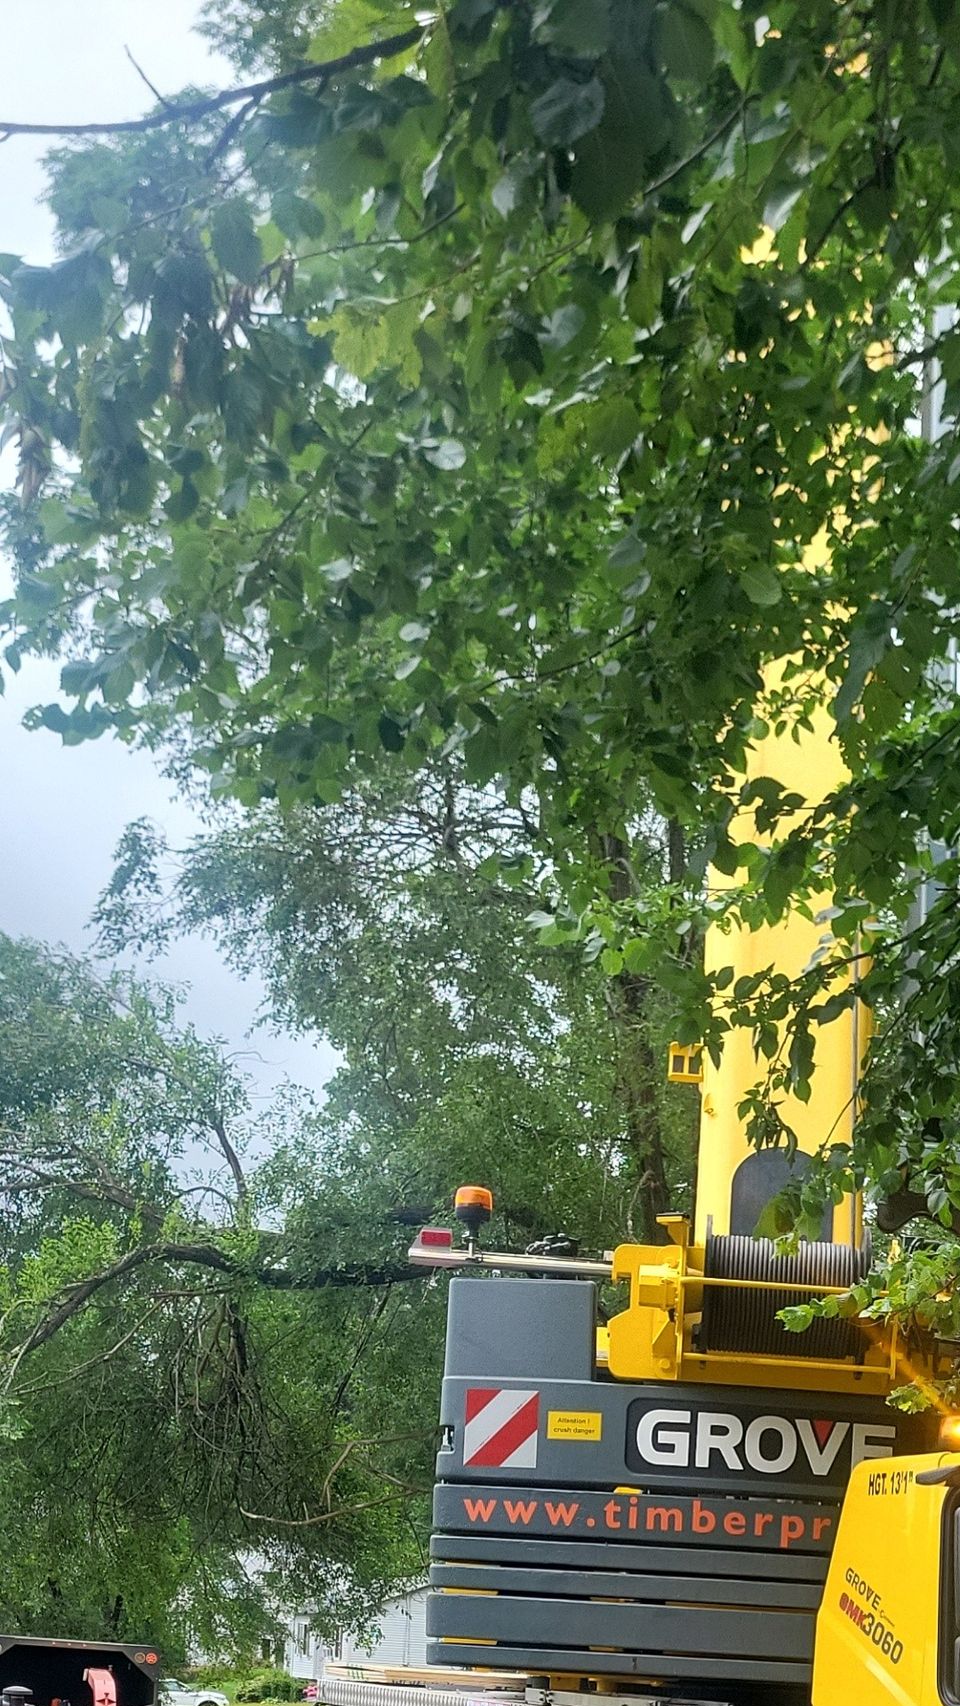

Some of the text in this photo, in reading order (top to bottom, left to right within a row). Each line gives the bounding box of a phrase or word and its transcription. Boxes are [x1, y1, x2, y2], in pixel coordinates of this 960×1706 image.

[573, 1427, 595, 1435] danger
[636, 1409, 896, 1476] GROVE
[868, 1472, 888, 1496] HGT.
[845, 1567, 882, 1610] GROVE
